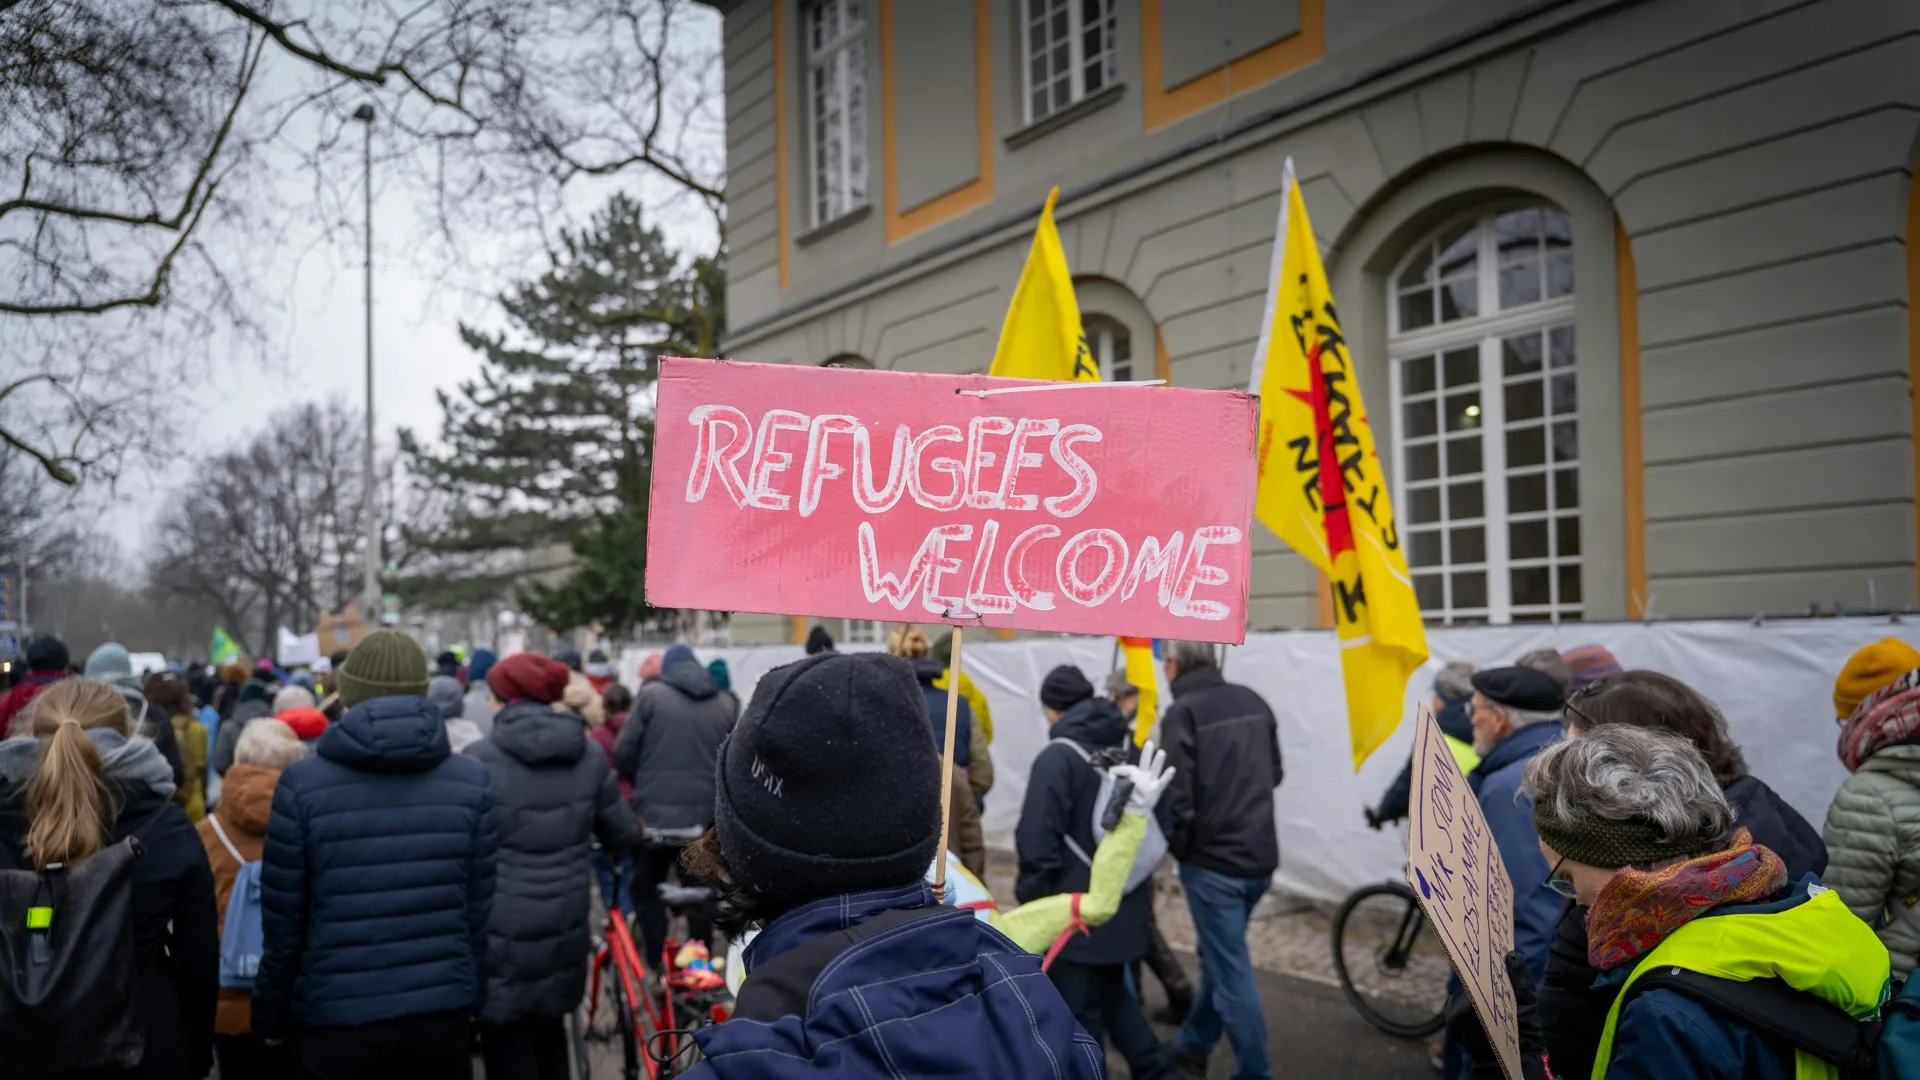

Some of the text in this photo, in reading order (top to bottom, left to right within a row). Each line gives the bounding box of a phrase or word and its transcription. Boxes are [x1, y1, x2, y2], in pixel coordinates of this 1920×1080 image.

[685, 404, 1103, 518] REFUGEES
[857, 519, 1243, 622] WELCOME
[1461, 794, 1481, 978] ZOSAMME
